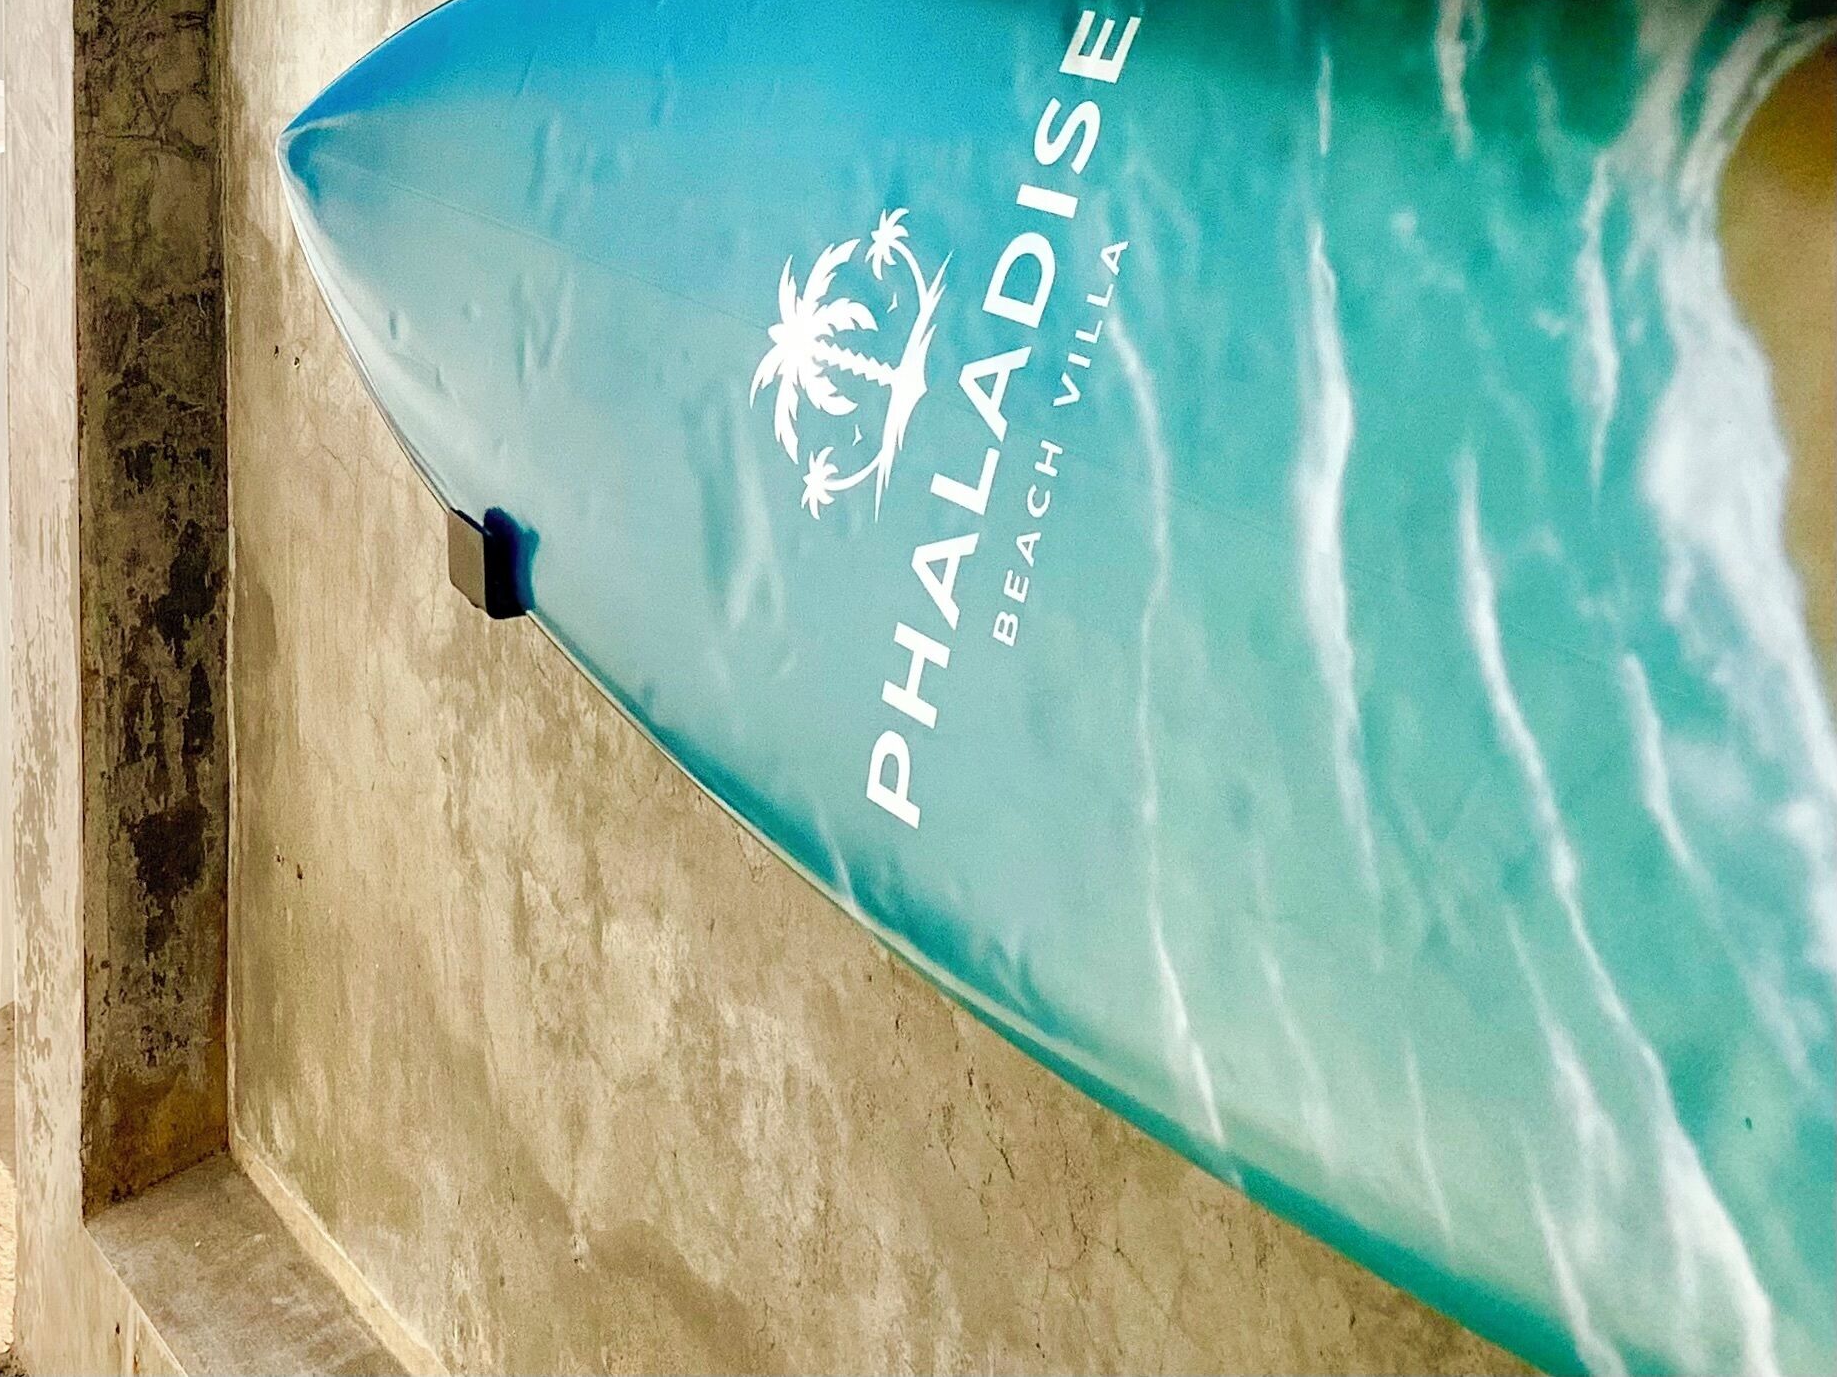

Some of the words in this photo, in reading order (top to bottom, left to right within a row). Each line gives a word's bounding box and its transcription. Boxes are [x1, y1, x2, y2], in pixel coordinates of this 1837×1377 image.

[866, 10, 1141, 830] PHALADISE
[992, 440, 1064, 647] BEACH
[1053, 240, 1129, 410] VILLA
